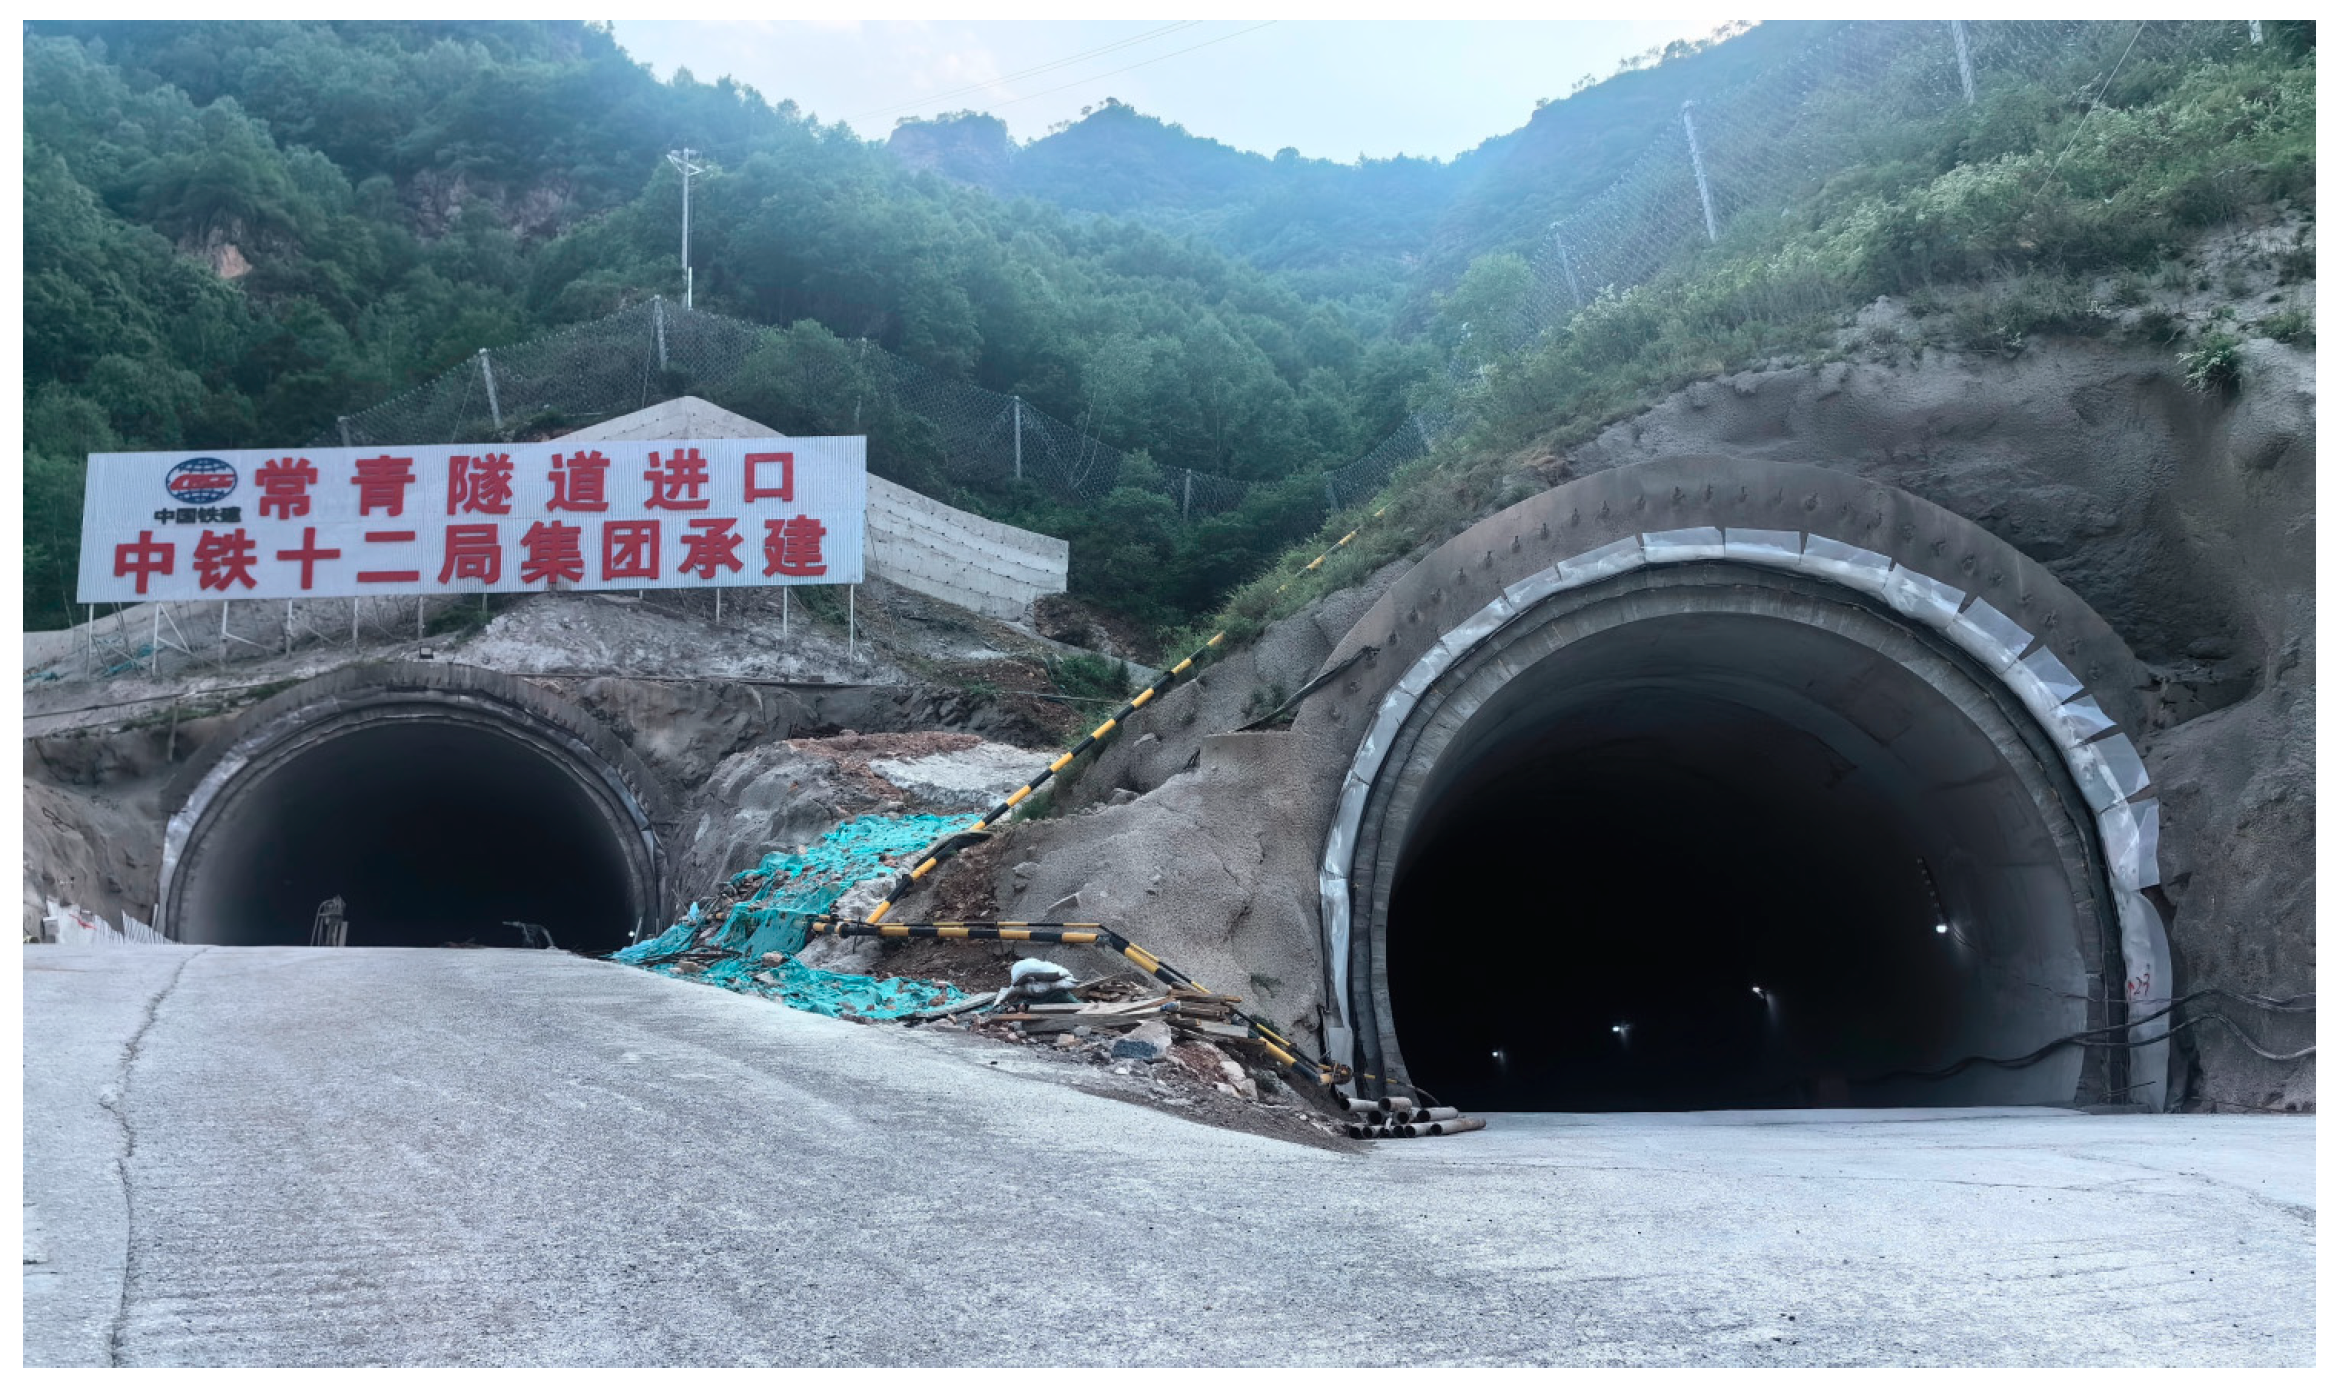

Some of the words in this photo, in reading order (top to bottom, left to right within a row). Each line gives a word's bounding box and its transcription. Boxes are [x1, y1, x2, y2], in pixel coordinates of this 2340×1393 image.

[154, 506, 242, 525] 中国铁建
[255, 449, 794, 520] 常青隧道进口
[114, 516, 827, 594] 中铁十二局集团承建
